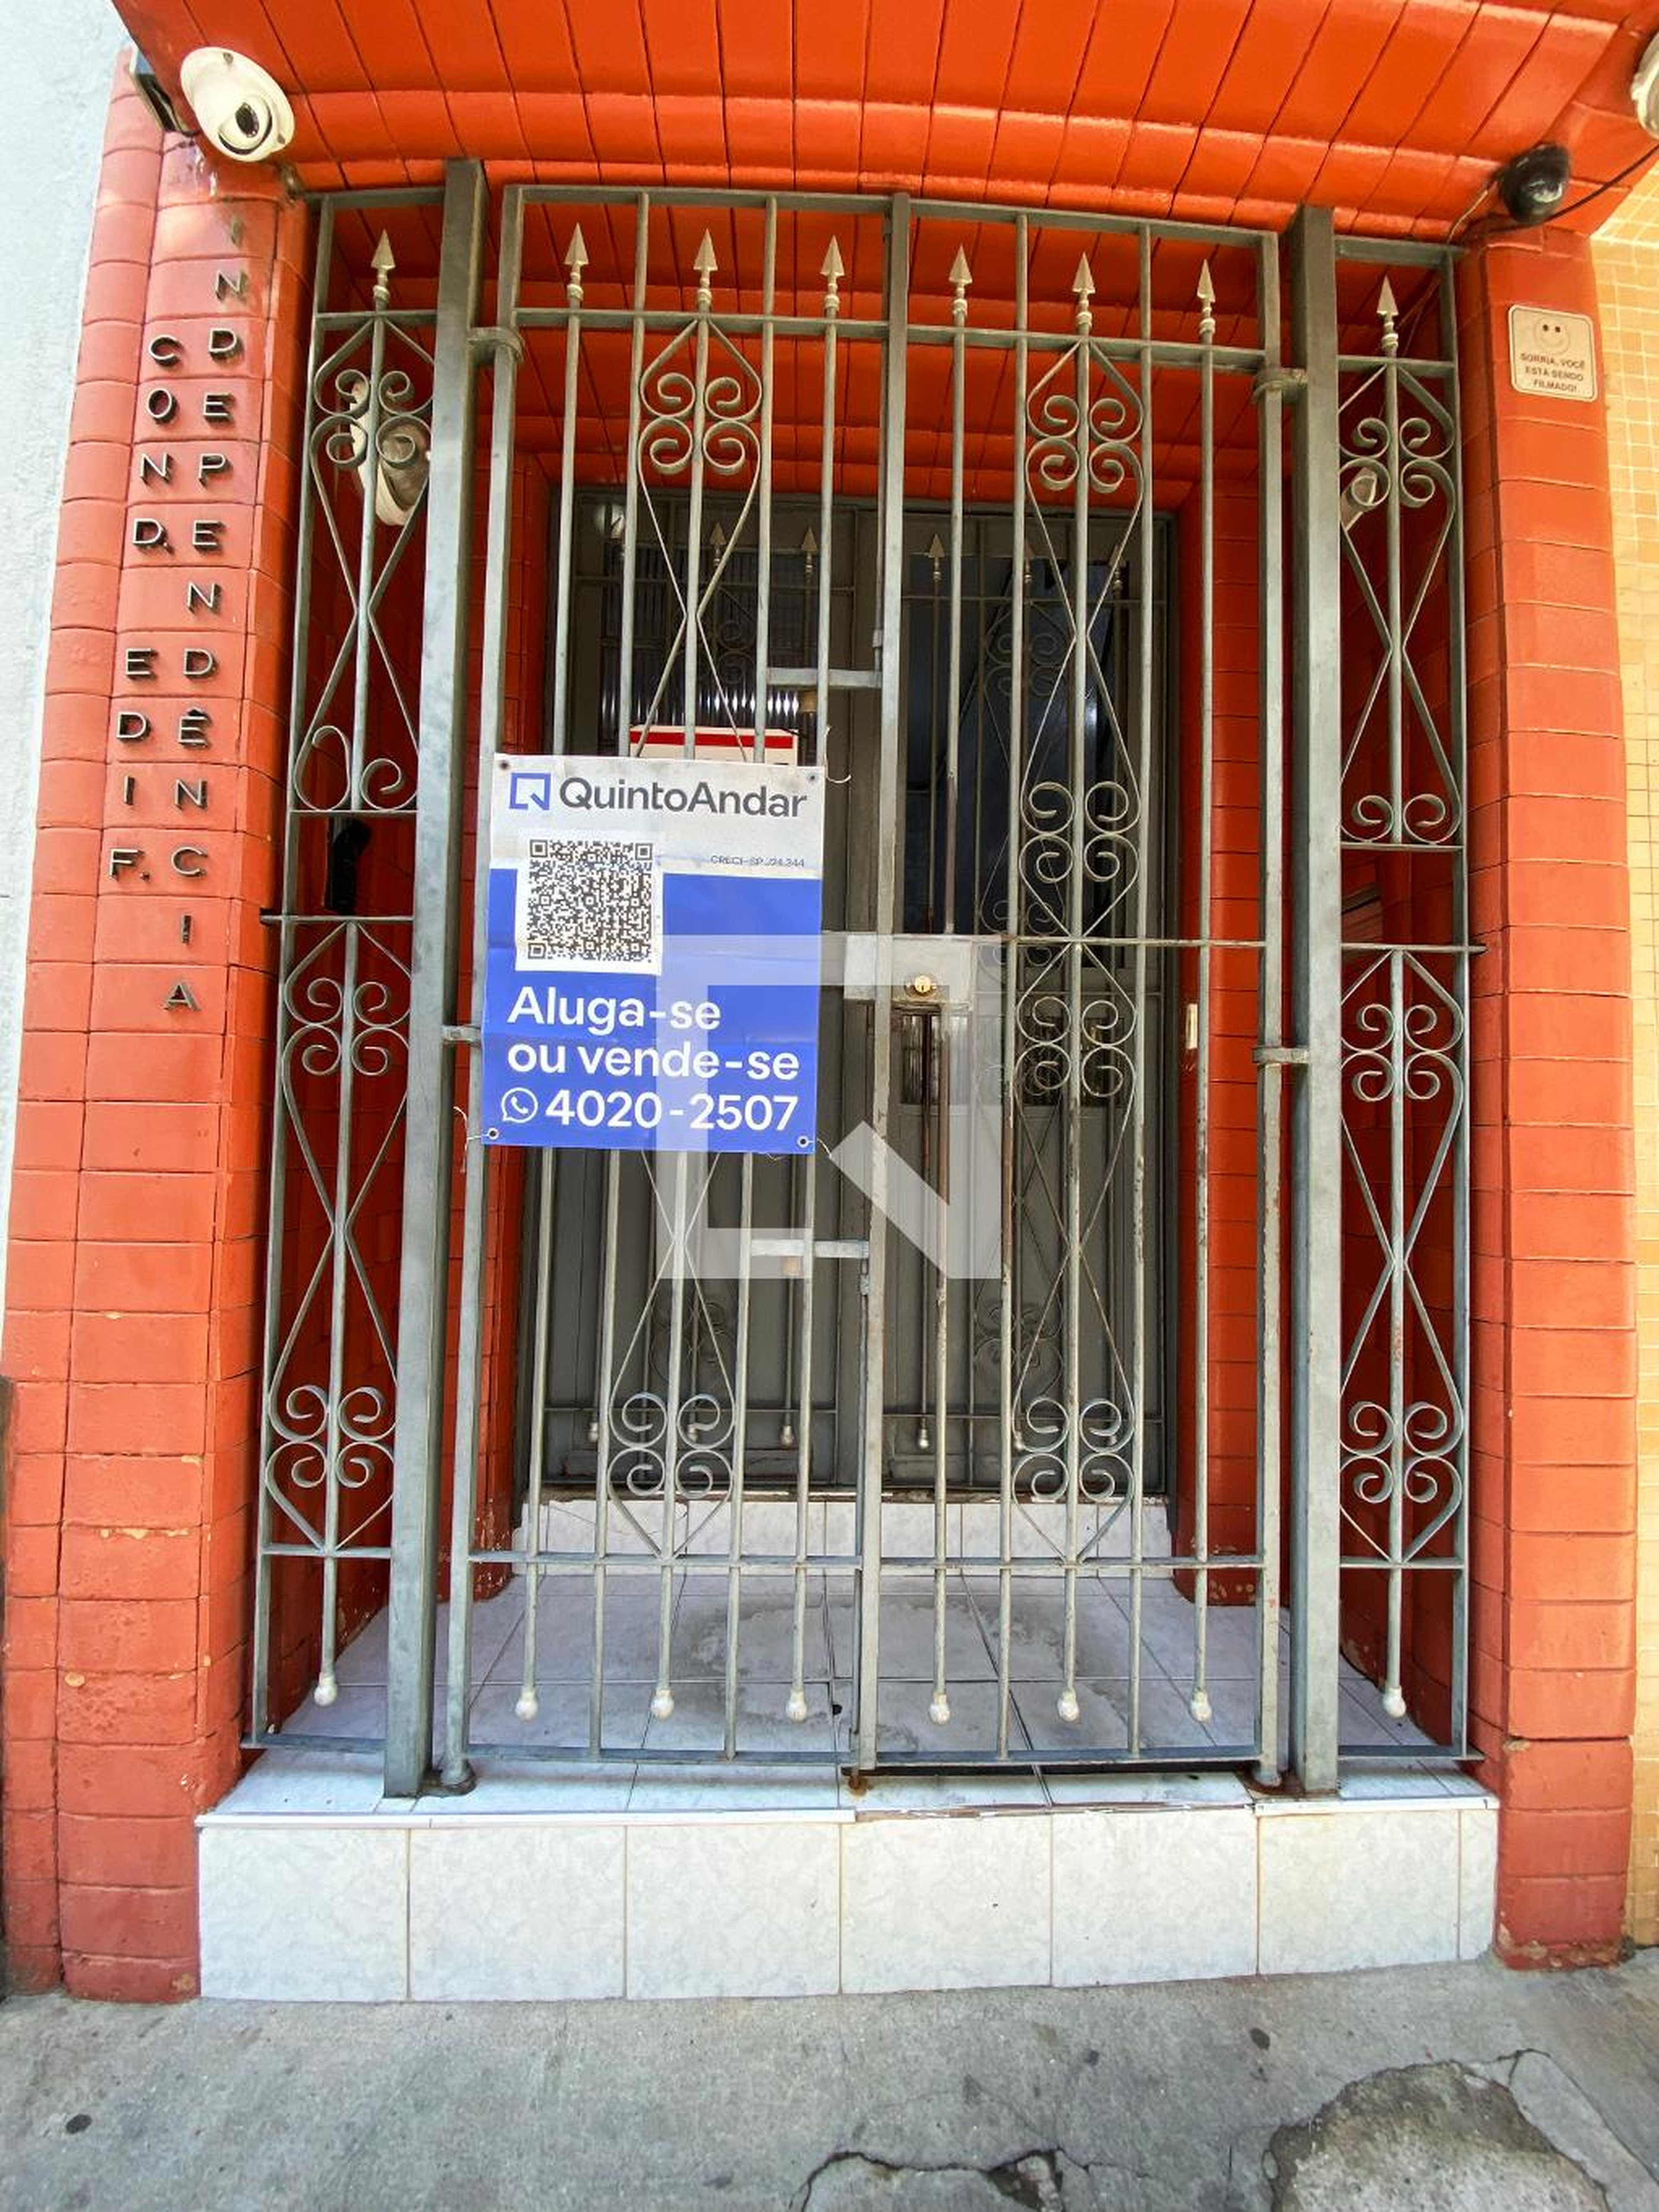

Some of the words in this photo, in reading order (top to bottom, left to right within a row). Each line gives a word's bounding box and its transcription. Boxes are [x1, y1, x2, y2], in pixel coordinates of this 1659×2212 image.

[559, 777, 807, 818] QuintoAndar
[507, 987, 721, 1036] Aluga-se
[508, 1045, 568, 1074] ou
[578, 1041, 799, 1080] vende-se
[545, 1088, 798, 1130] 4020-2507
